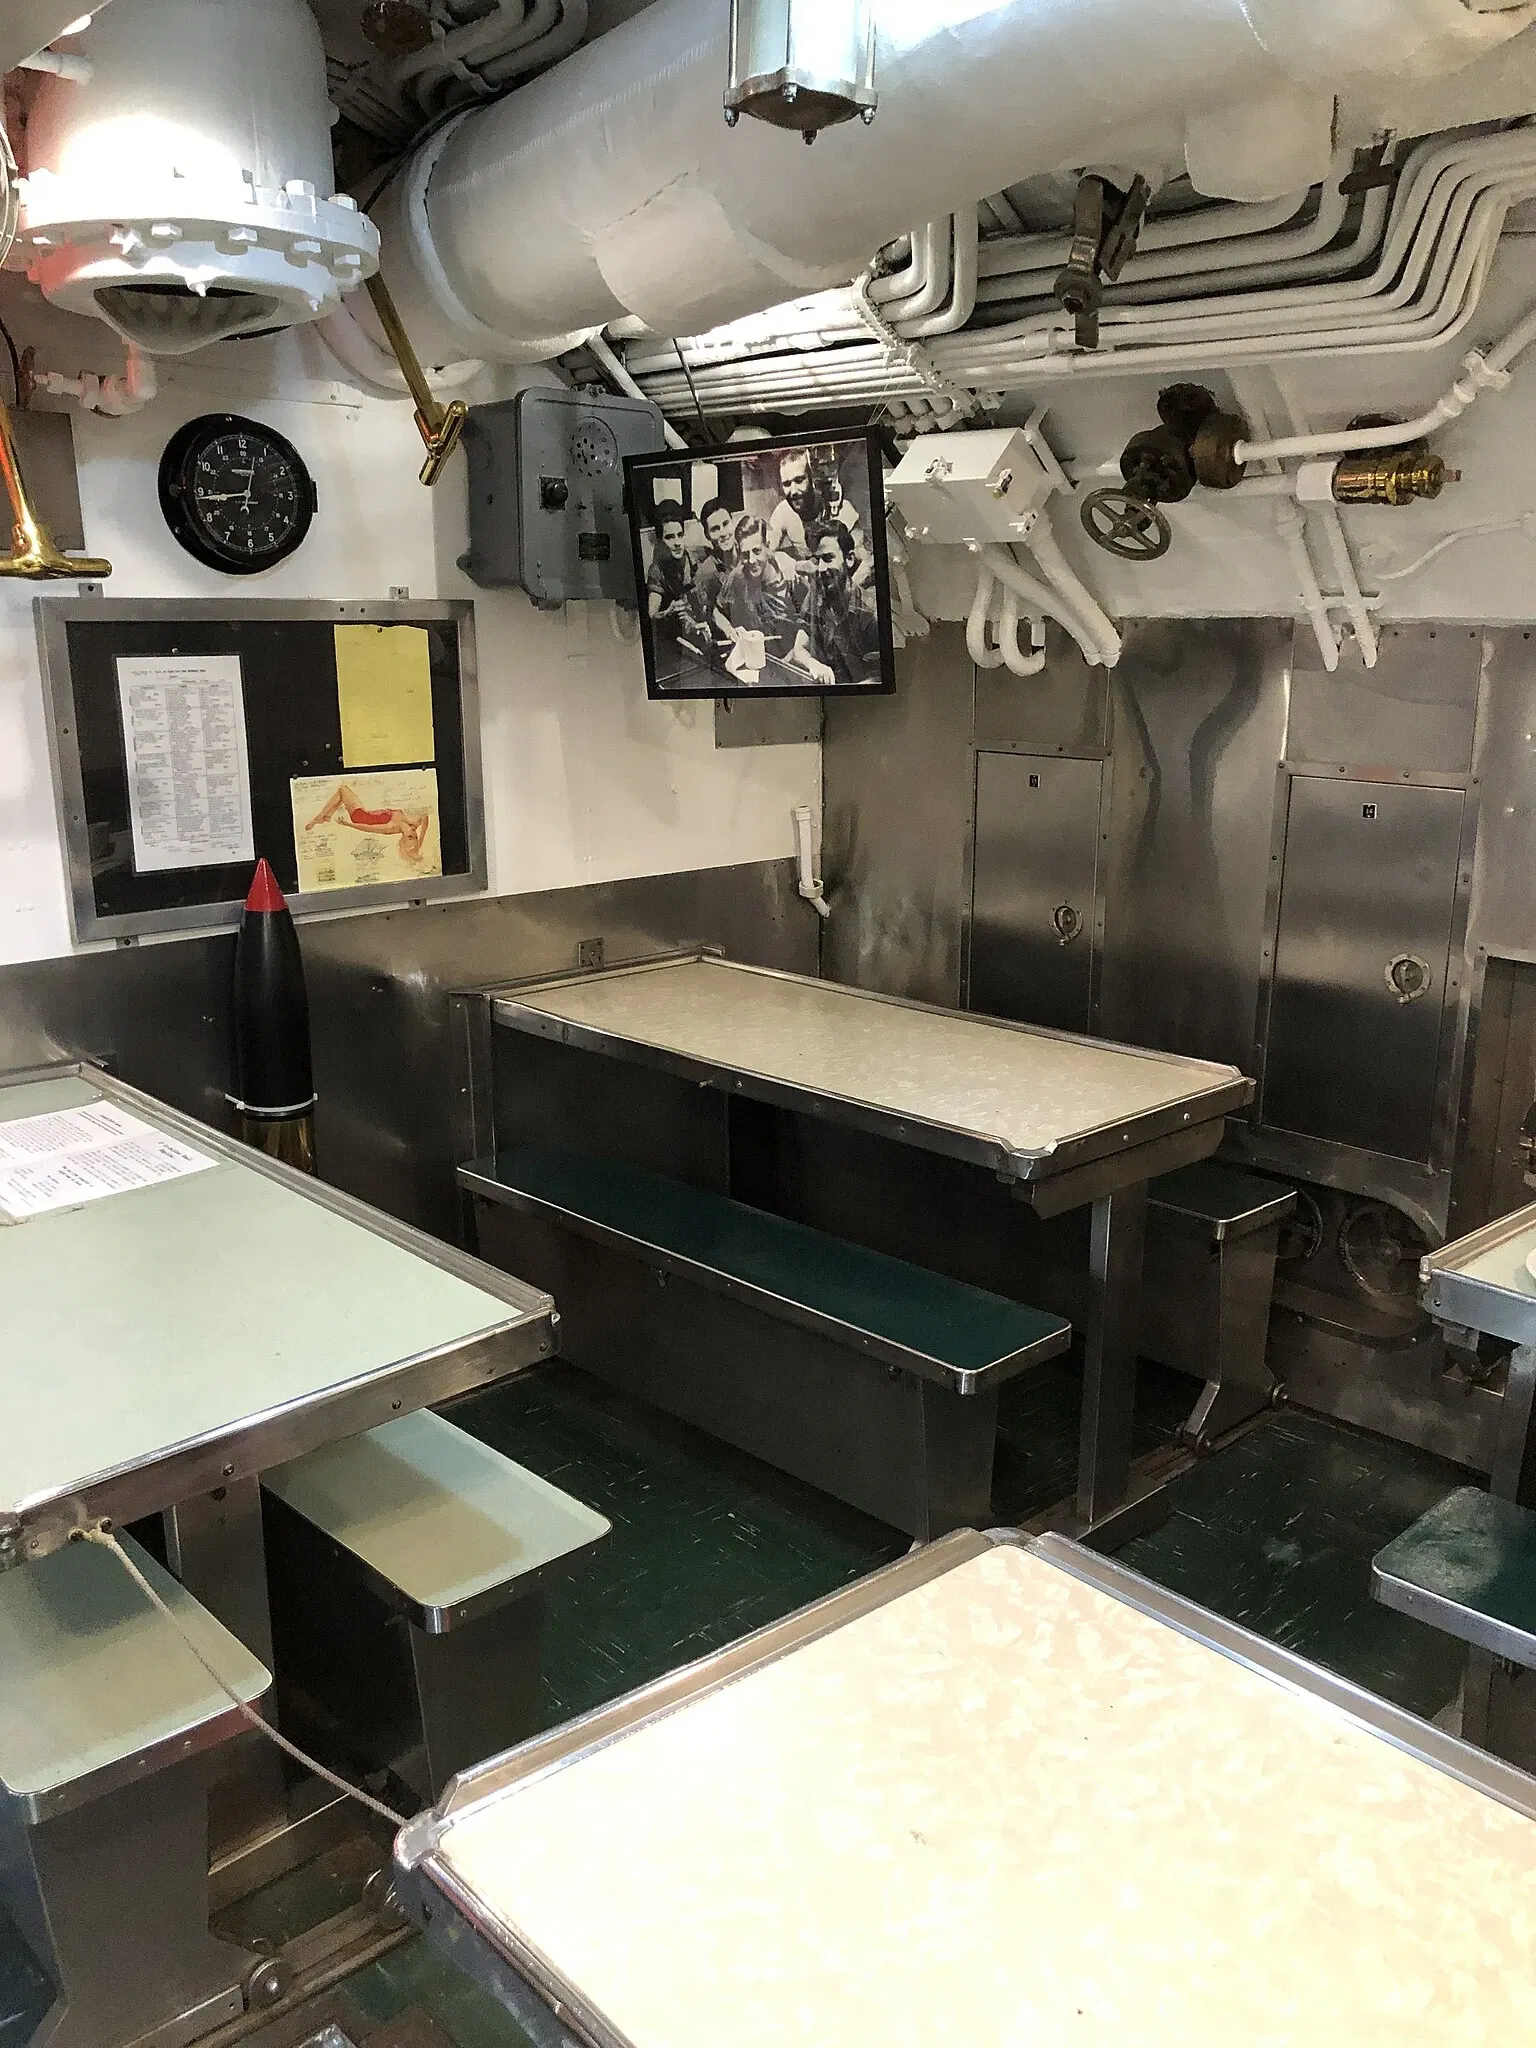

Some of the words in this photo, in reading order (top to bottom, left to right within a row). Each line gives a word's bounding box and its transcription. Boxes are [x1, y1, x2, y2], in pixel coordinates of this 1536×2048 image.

[238, 439, 247, 449] 12
[217, 445, 224, 455] 11
[263, 447, 267, 457] 1
[202, 461, 211, 472] 10
[279, 466, 286, 476] 2
[197, 487, 204, 496] 9
[287, 491, 294, 501] 3
[206, 512, 213, 523] 8
[283, 515, 290, 524] 4
[224, 531, 231, 541] 7
[268, 532, 275, 542] 5
[247, 539, 254, 548] 6
